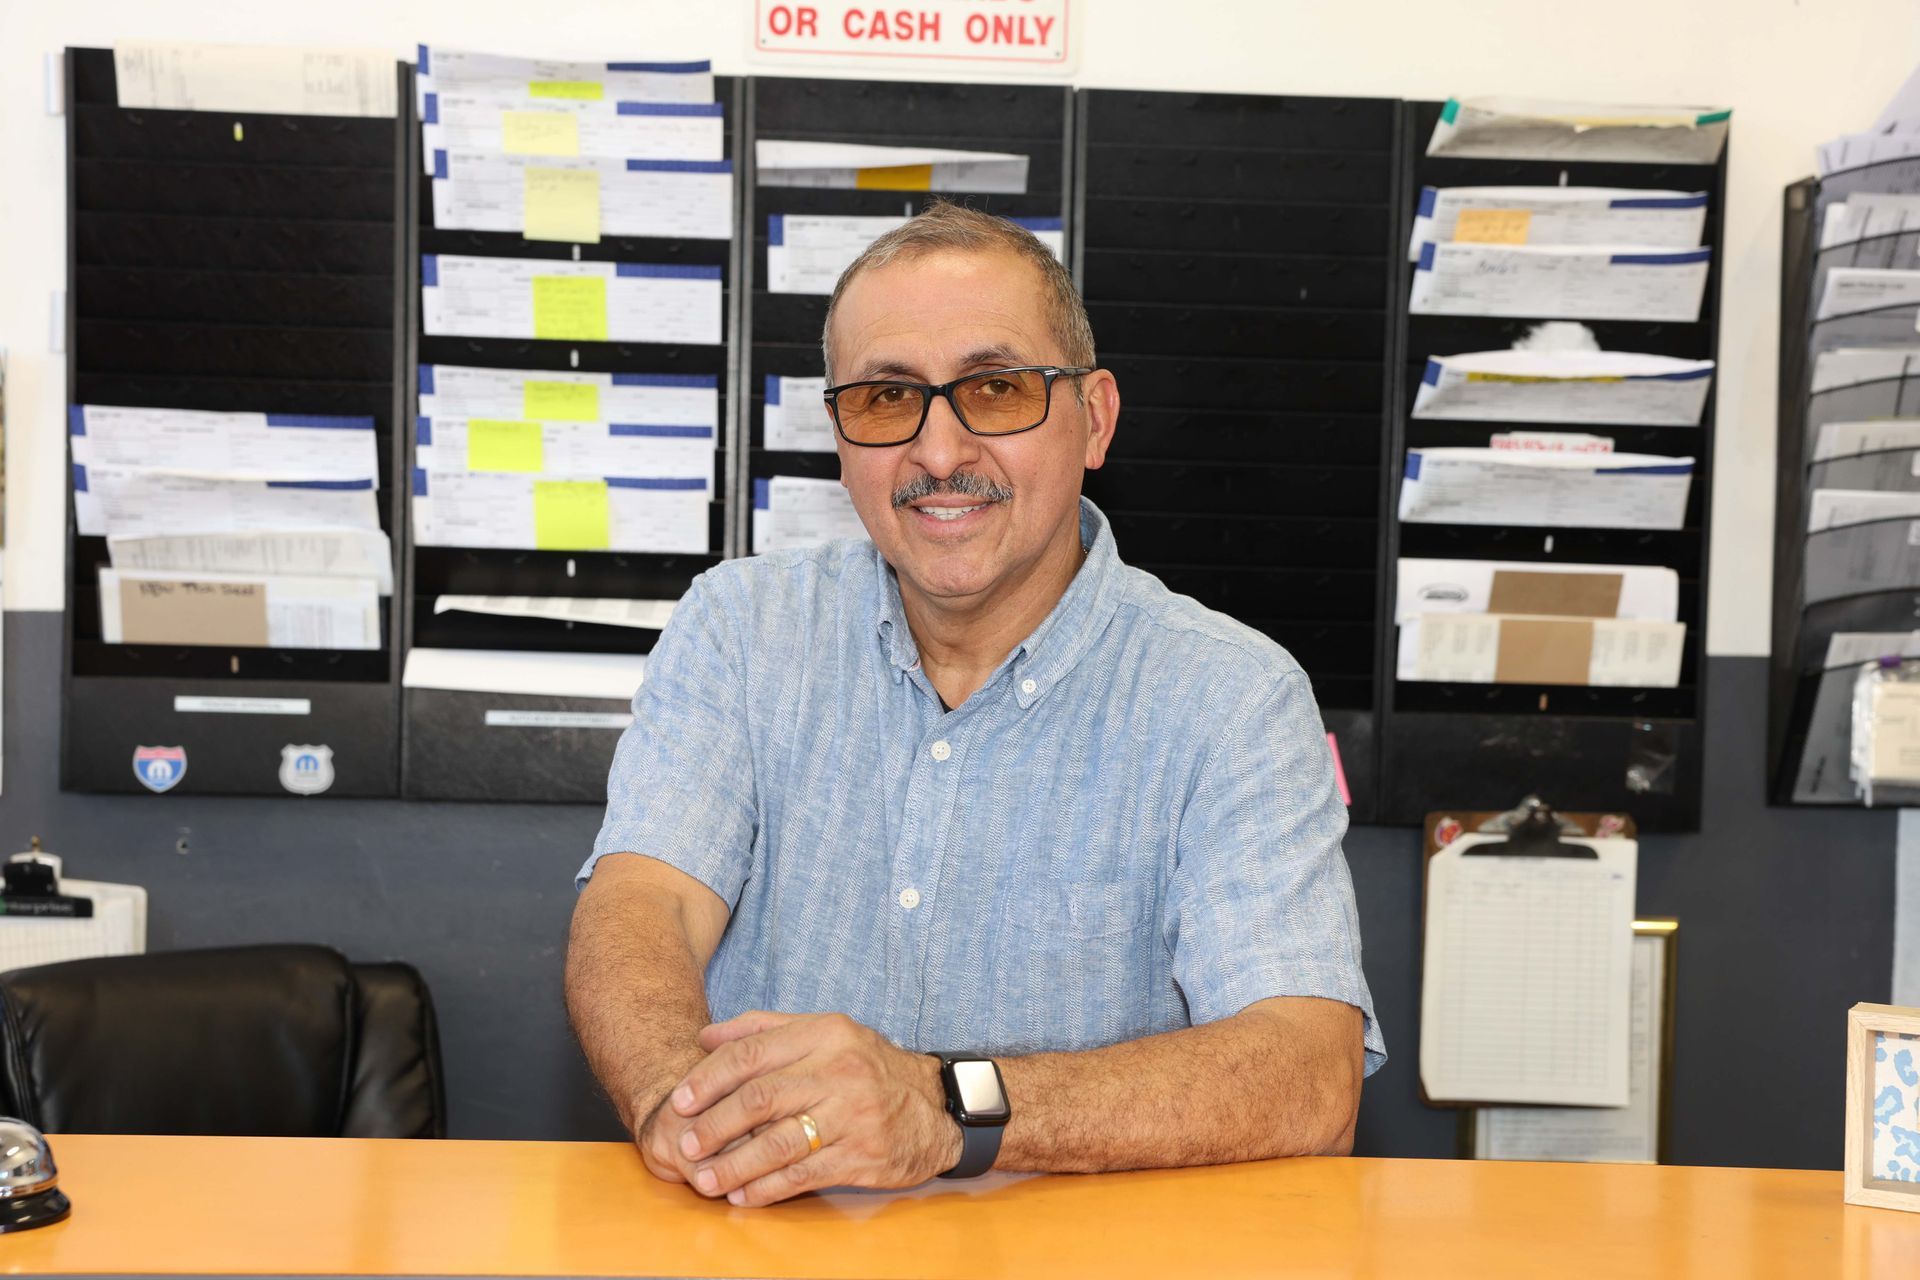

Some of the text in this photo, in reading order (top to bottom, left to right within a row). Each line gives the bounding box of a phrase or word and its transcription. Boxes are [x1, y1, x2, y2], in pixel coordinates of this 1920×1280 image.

[769, 6, 1055, 46] OR CASH ONLY
